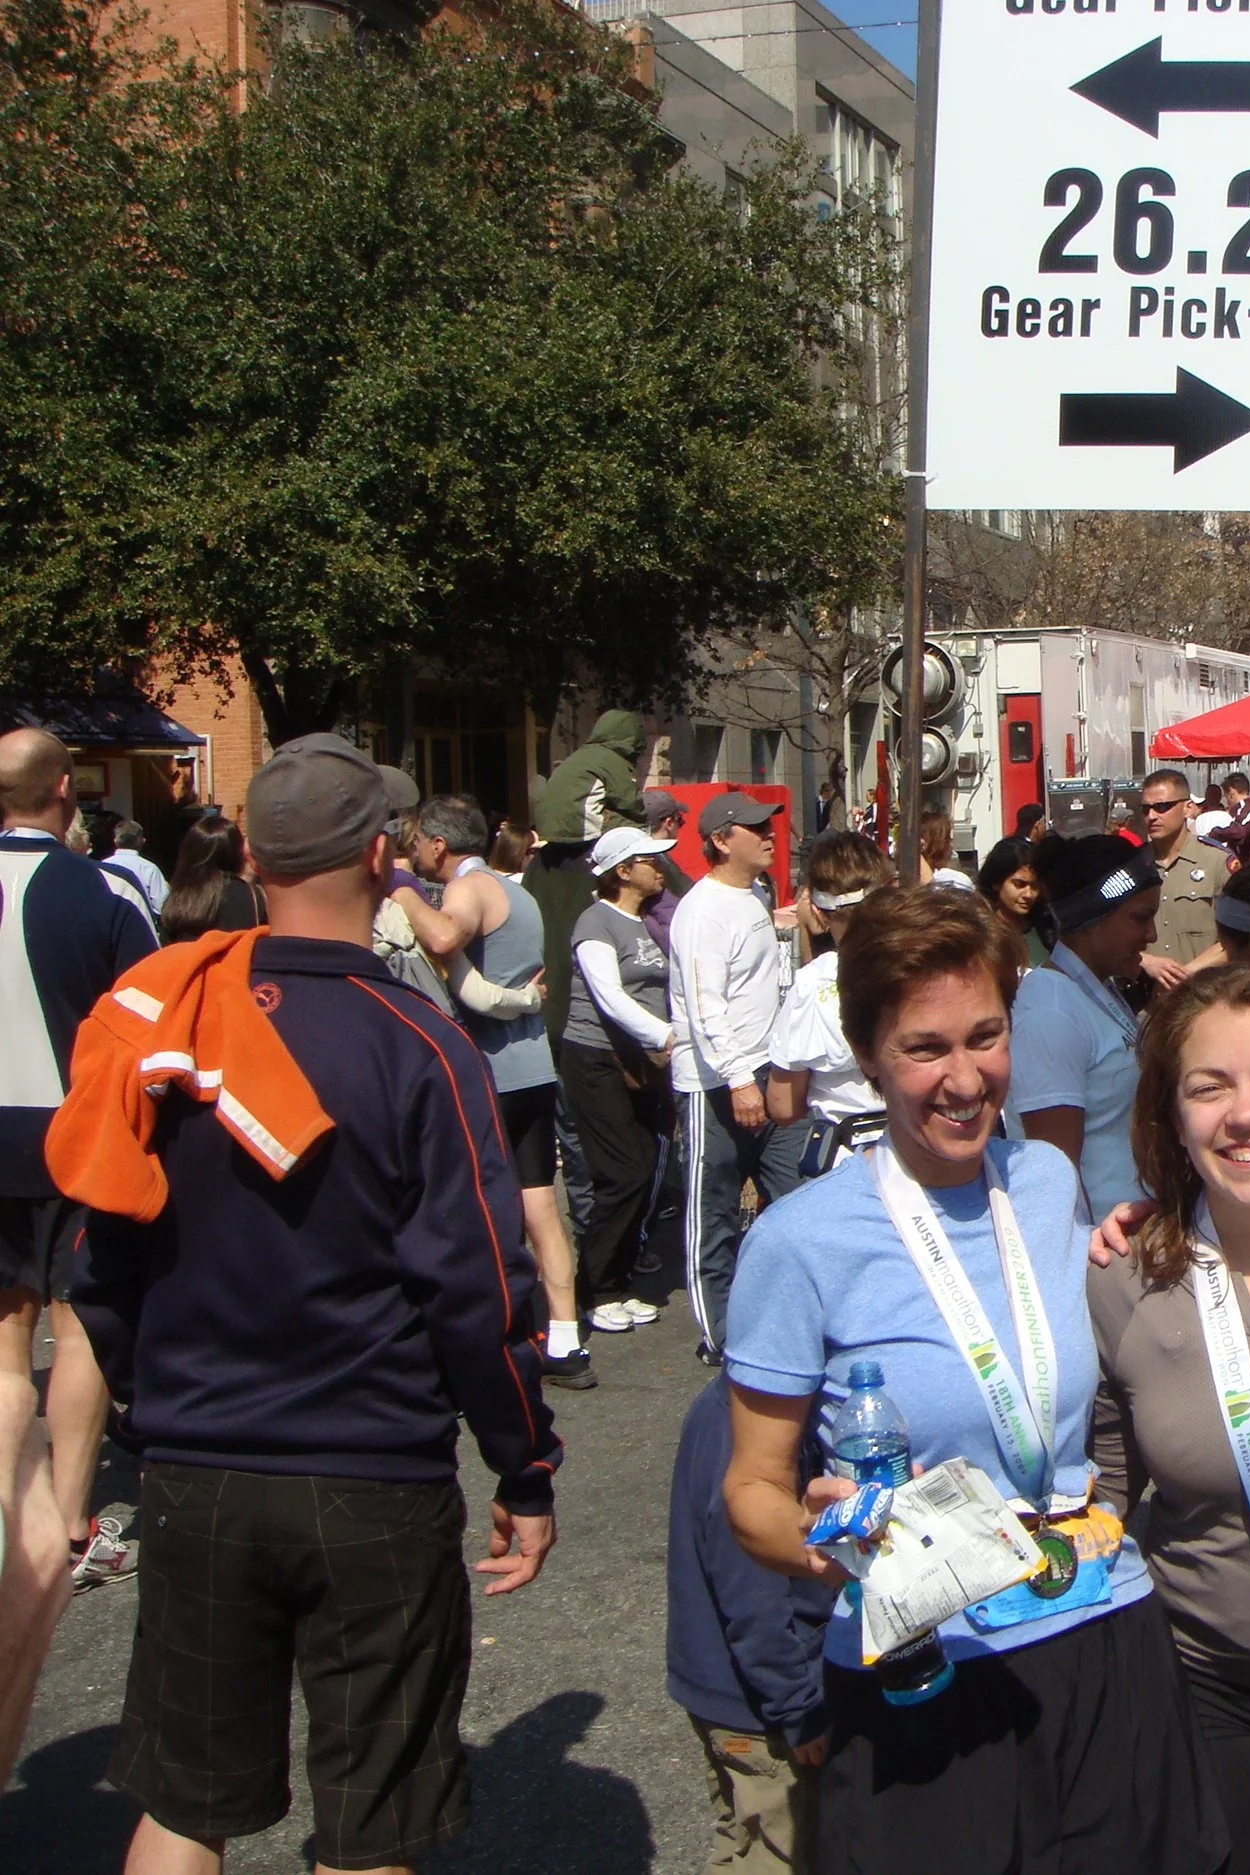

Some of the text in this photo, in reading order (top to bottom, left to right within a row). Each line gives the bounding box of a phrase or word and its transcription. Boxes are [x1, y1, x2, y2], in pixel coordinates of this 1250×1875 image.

[980, 285, 1102, 339] Gear
[986, 1384, 1008, 1432] FEBRUARY
[996, 1378, 1014, 1413] 18TH
[882, 1629, 936, 1664] OWERAD
